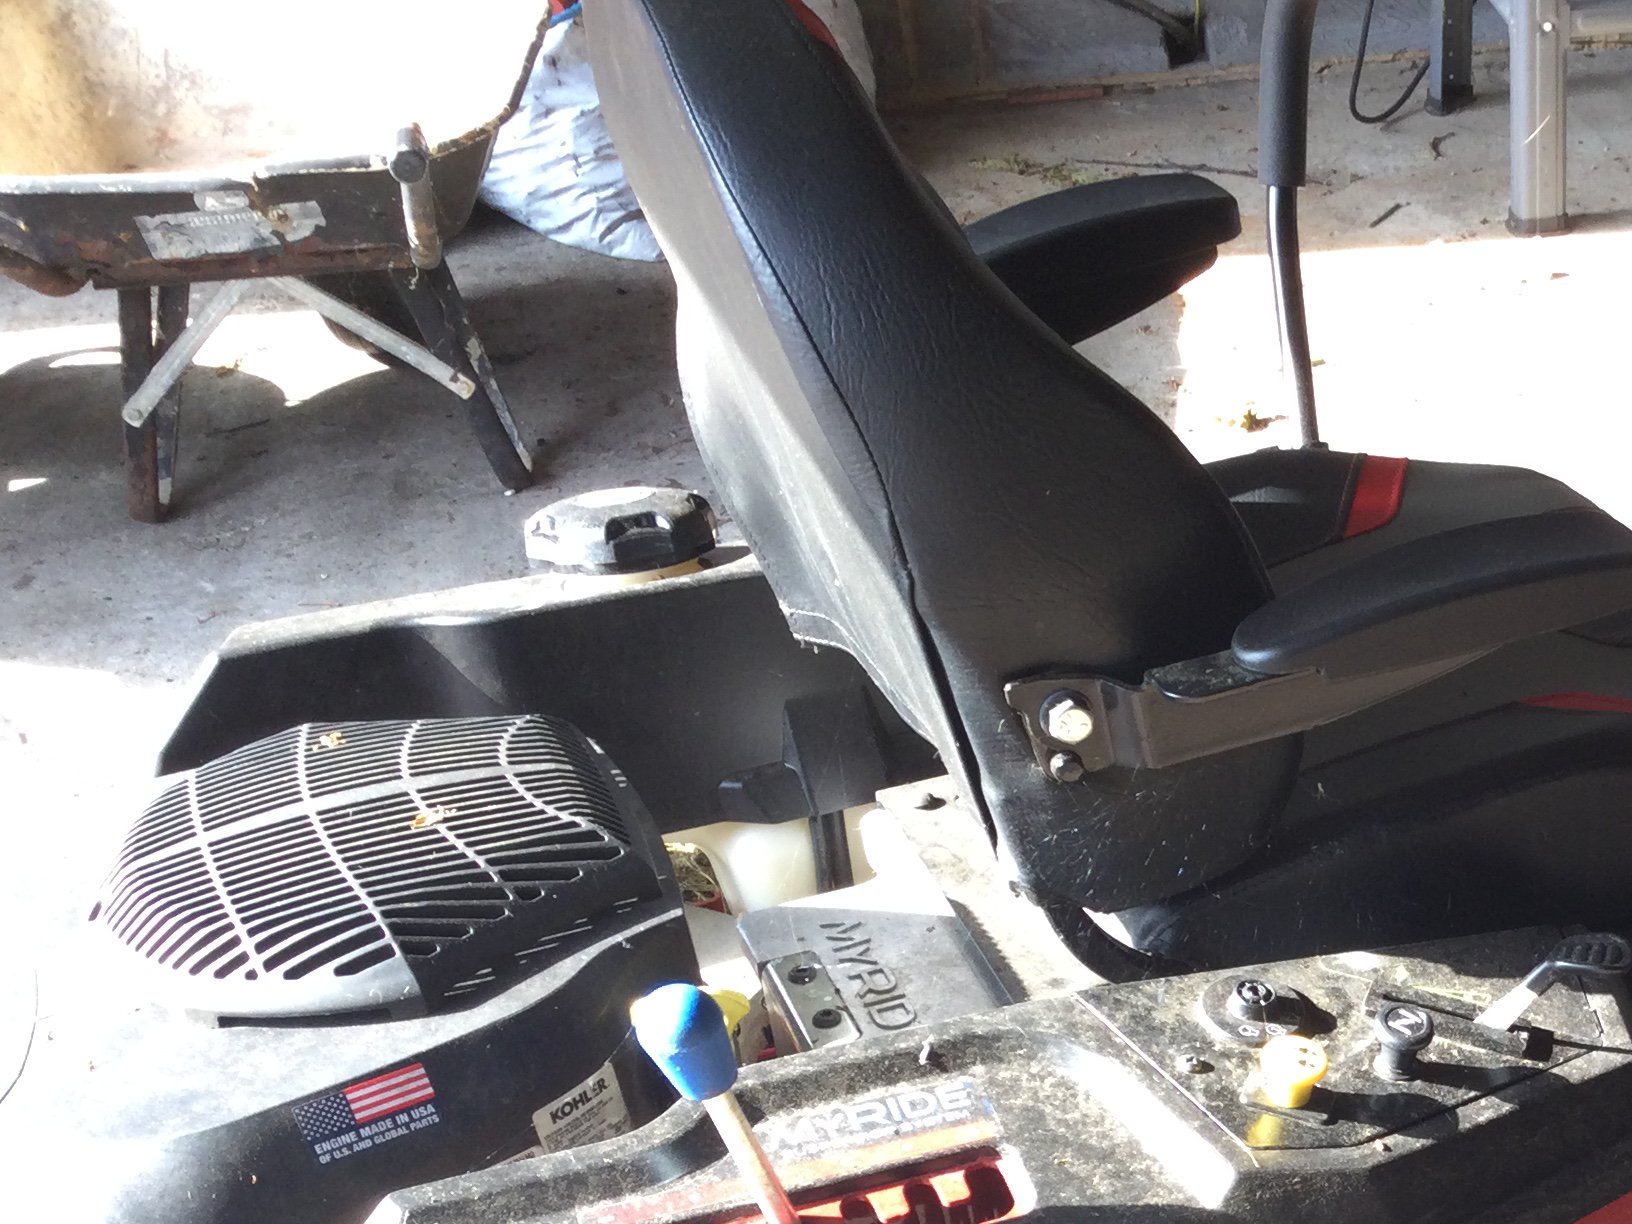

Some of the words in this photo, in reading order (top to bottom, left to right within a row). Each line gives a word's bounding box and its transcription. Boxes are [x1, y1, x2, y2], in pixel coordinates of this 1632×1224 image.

[313, 1131, 359, 1155] ENGINE
[359, 1118, 395, 1139] MADE
[395, 1112, 410, 1125] IN
[410, 1103, 436, 1120] USA
[318, 1154, 332, 1165] OF
[332, 1146, 352, 1160] U.S.
[352, 1138, 373, 1153] AND
[373, 1125, 410, 1145] GLOBAL
[409, 1113, 440, 1132] PARTS
